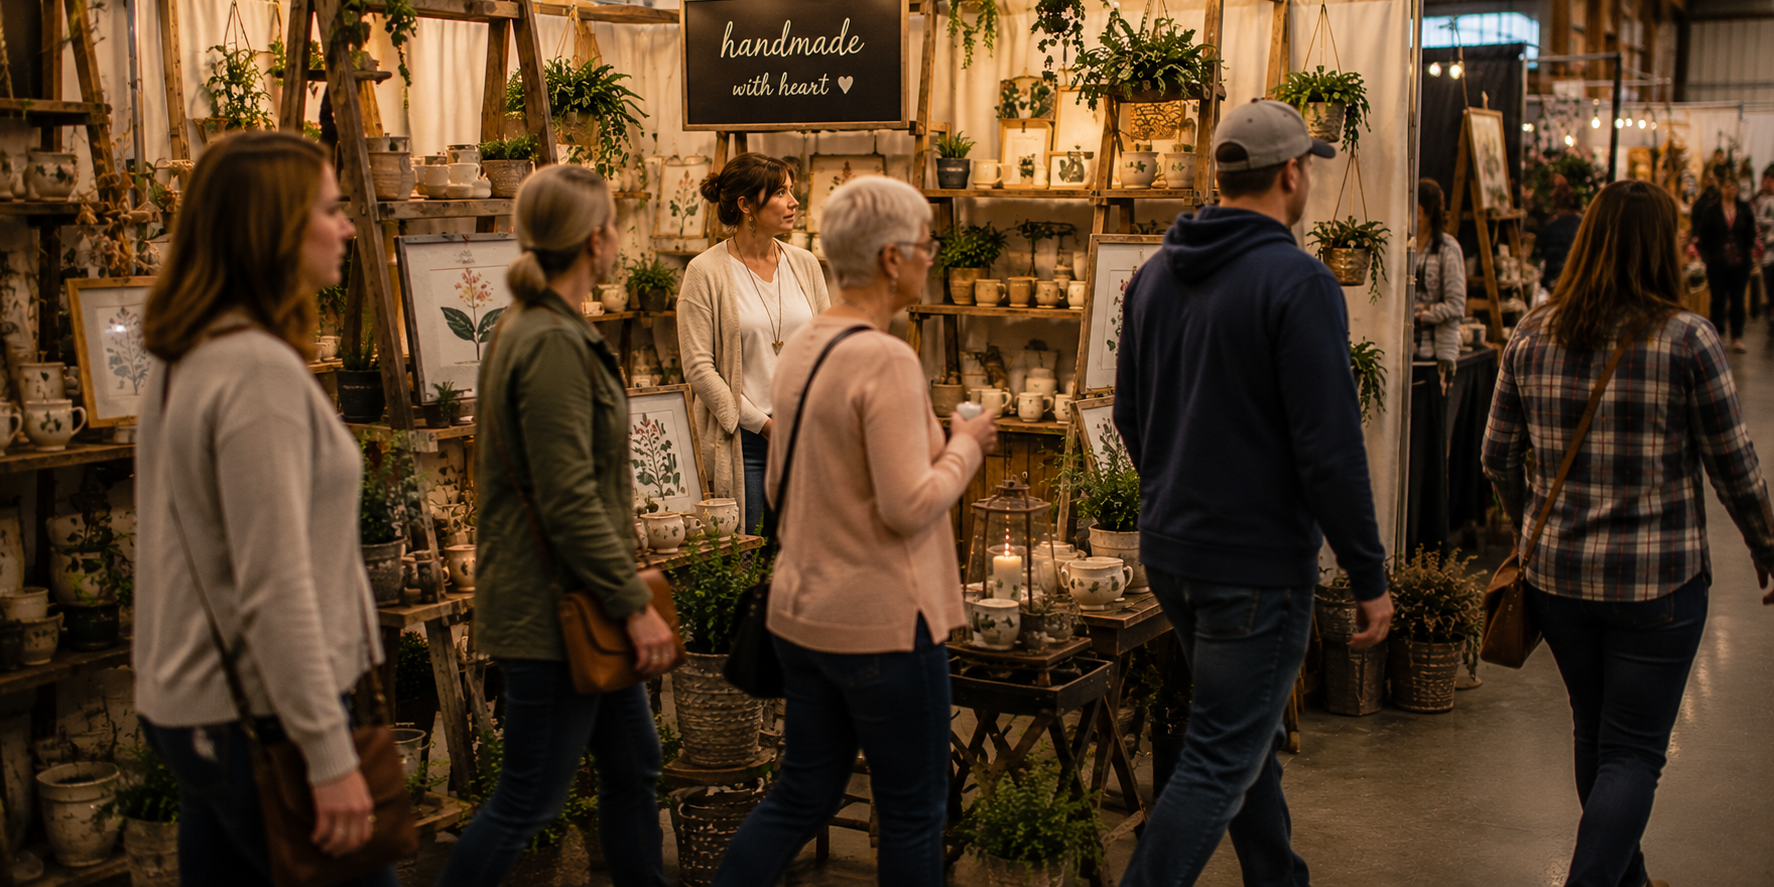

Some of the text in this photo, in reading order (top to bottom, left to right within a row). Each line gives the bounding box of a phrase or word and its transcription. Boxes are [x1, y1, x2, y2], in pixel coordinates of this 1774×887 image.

[720, 17, 865, 59] handmade
[732, 71, 830, 96] with heart
